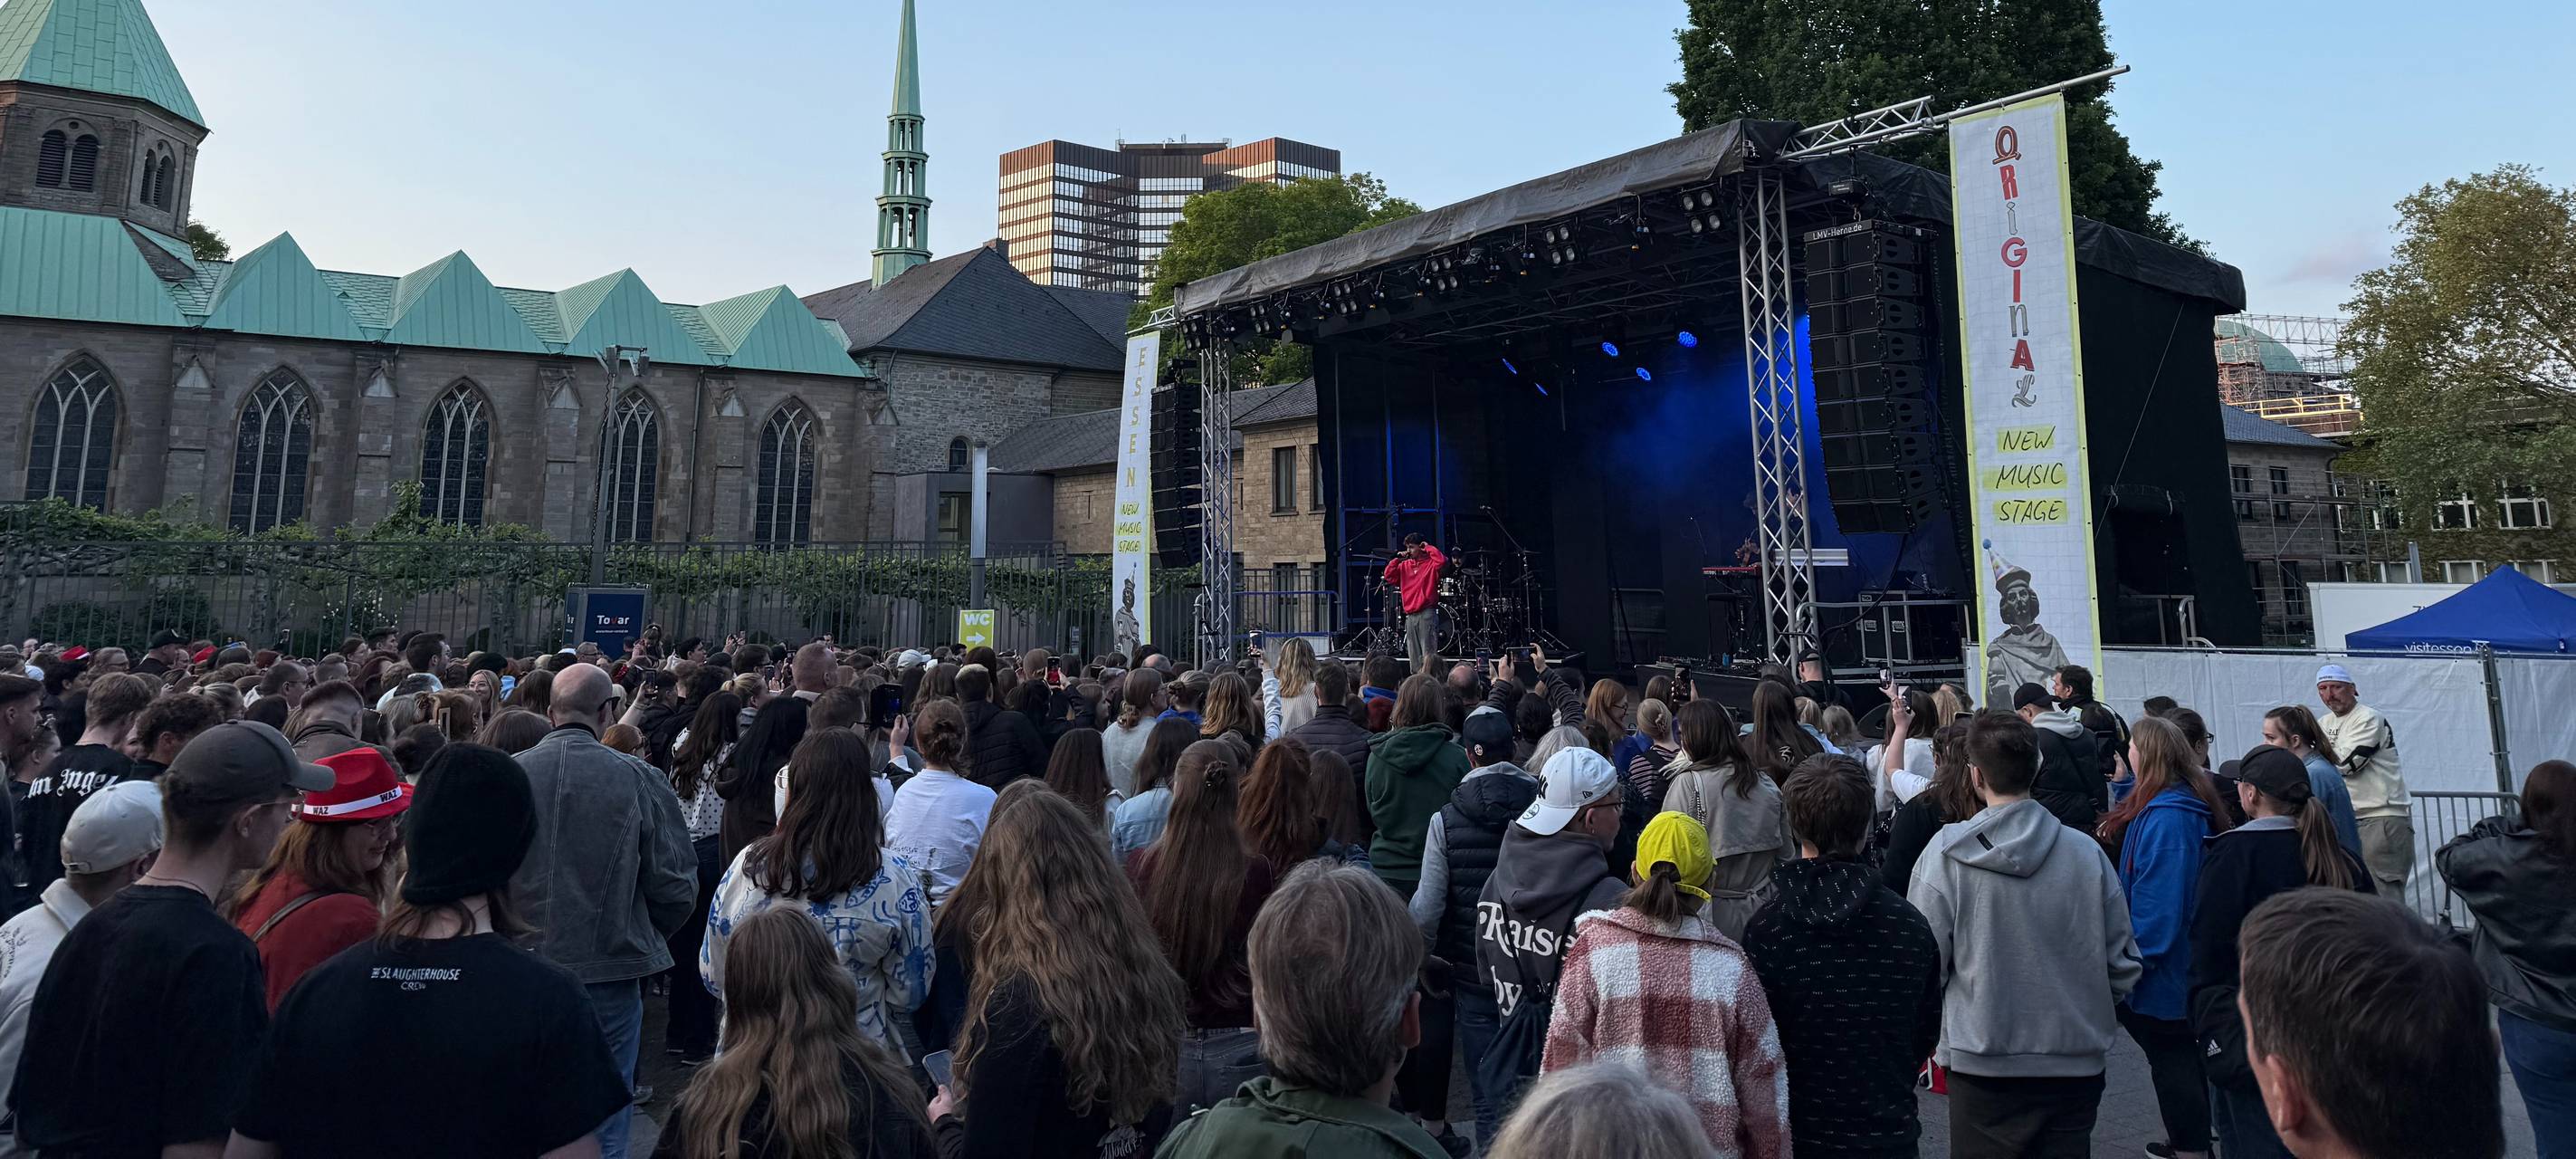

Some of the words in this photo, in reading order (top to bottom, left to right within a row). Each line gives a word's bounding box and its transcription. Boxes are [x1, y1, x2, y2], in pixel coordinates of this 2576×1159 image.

[1812, 224, 1863, 240] LMV-Herne.de
[1126, 347, 1147, 488] ESSEN
[2003, 426, 2056, 451] NEW
[1996, 463, 2063, 489] MUSIC
[1121, 503, 1140, 515] NEW
[1999, 500, 2063, 523] STAGE
[1118, 522, 1141, 534] MUSIC
[1118, 541, 1140, 553] STAGE
[596, 615, 630, 625] Tovar
[964, 613, 990, 626] WC
[380, 790, 397, 802] WAZ
[312, 807, 329, 815] WAZ
[380, 967, 462, 981] SLAUGHTERHOUSE
[400, 981, 426, 991] CREW
